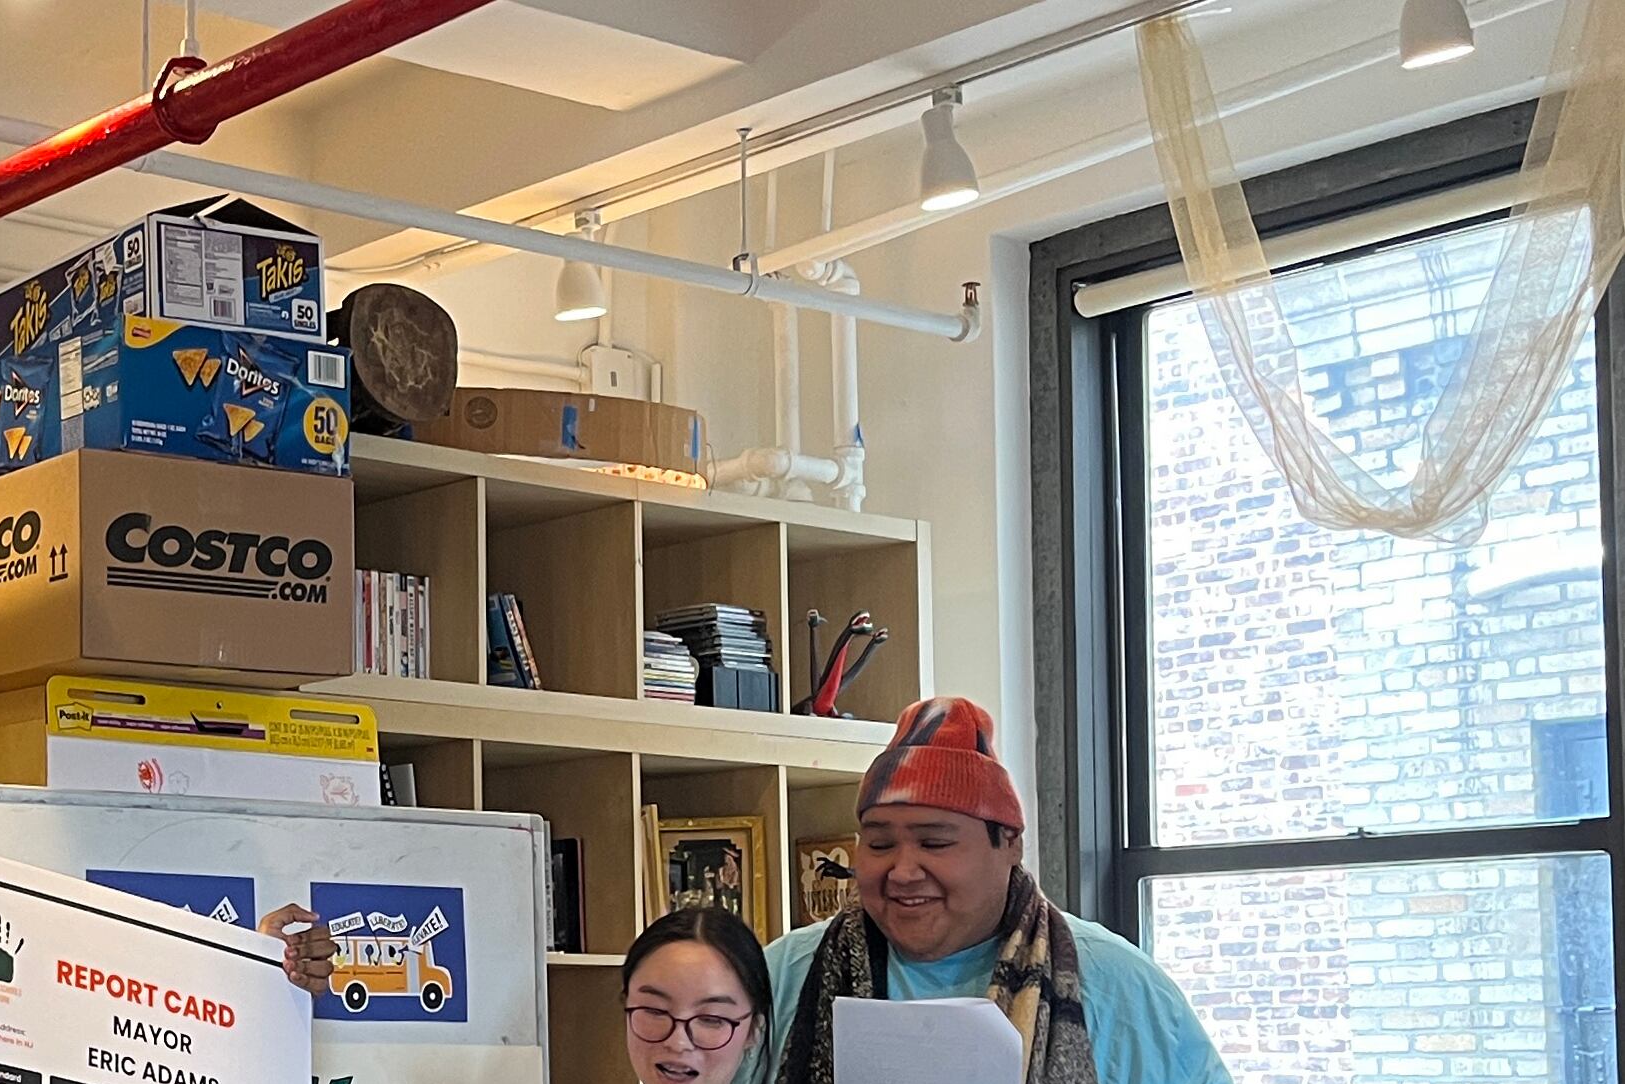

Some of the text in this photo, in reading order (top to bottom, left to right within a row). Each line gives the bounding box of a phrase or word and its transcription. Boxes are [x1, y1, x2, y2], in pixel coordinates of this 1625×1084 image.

[127, 237, 141, 258] 50
[256, 257, 305, 298] Takis
[10, 291, 49, 357] Takis
[297, 305, 314, 320] 50
[227, 357, 281, 396] Doritos
[5, 384, 40, 405] Doritos
[313, 406, 338, 436] 50
[106, 512, 333, 581] COSTCO
[2, 554, 38, 583] .COM
[269, 581, 328, 604] .COM
[59, 709, 90, 722] Post-it
[57, 960, 158, 1008] REPORT
[164, 989, 236, 1028] CARD
[113, 1015, 192, 1054] MAYOR
[88, 1047, 136, 1077] ERIC
